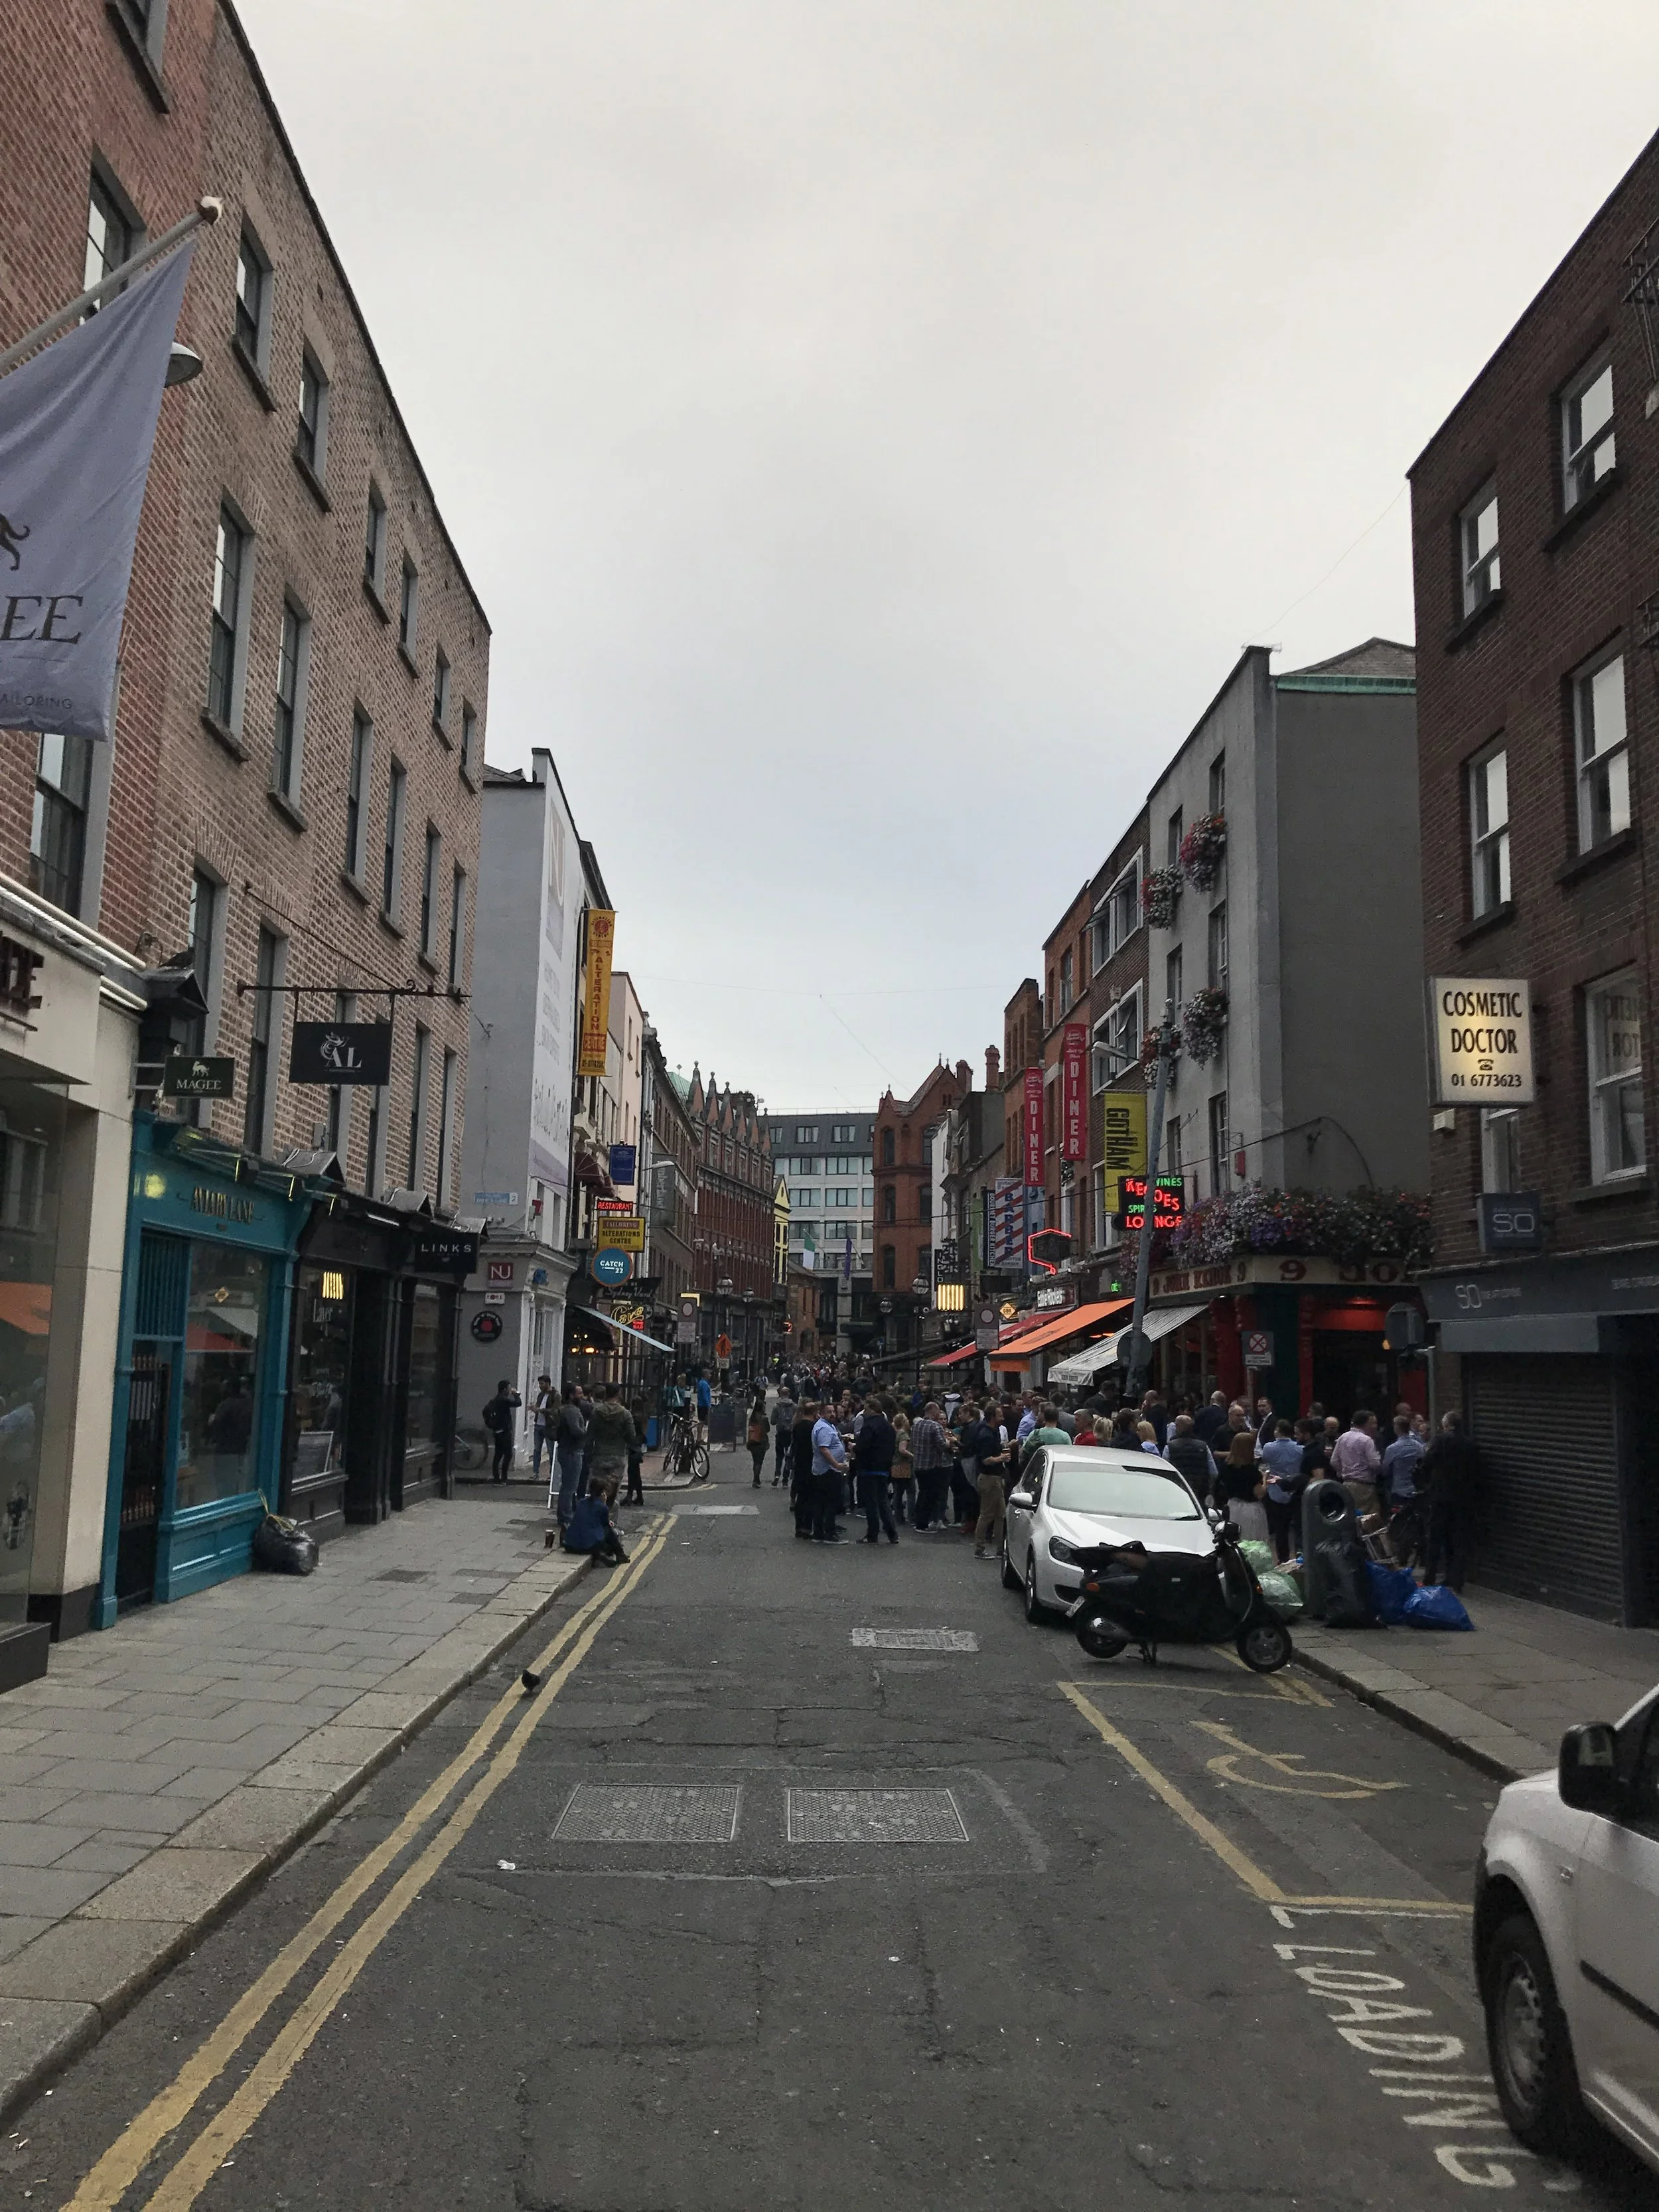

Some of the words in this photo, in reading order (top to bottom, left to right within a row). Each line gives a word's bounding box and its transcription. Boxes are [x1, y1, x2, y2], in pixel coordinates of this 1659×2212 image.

[591, 956, 603, 1031] ALTERATION
[1443, 991, 1523, 1018] COSMETIC
[1451, 1028, 1518, 1055] DOCTOR
[176, 1078, 222, 1090] MAGEE
[1451, 1073, 1465, 1087] 01
[1470, 1074, 1522, 1088] 6773623
[1069, 1061, 1080, 1155] DINER
[1029, 1100, 1039, 1182] DINER
[1106, 1108, 1141, 1170] GOTHAM
[598, 1201, 633, 1211] RESTAURANT
[1128, 1205, 1157, 1214] SPIRS
[1004, 1193, 1015, 1257] BARBER
[1125, 1216, 1183, 1228] LONGE
[421, 1243, 472, 1252] LINKS
[491, 1266, 511, 1279] NU
[1279, 1260, 1307, 1282] 9
[1273, 1943, 1583, 2191] LOADING
